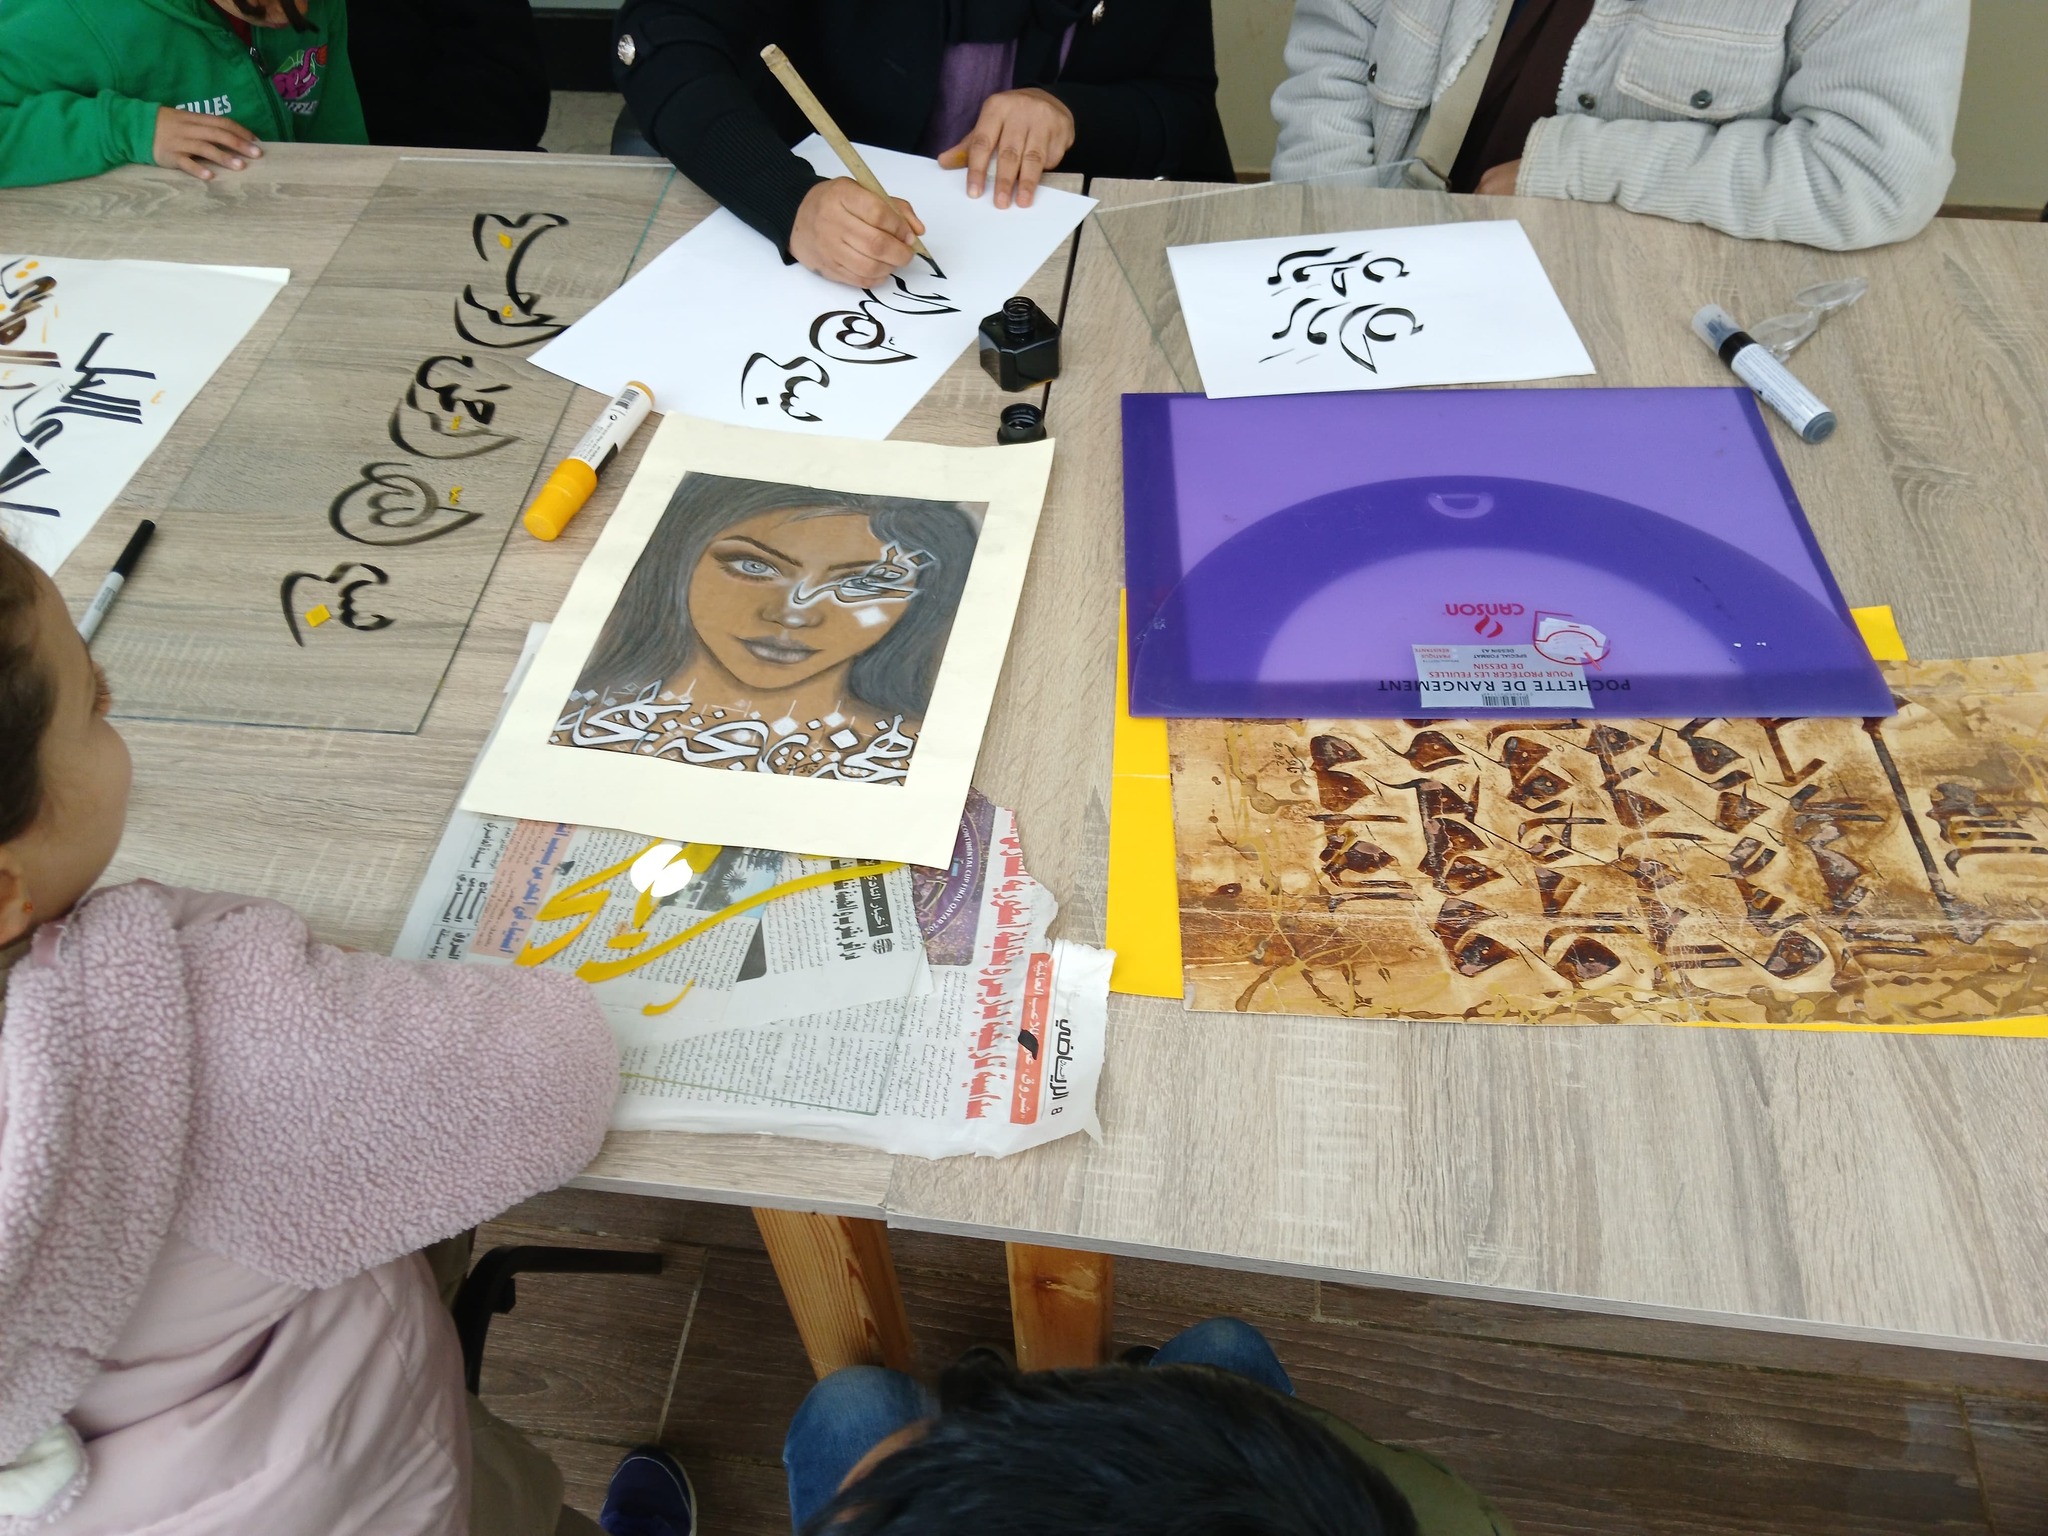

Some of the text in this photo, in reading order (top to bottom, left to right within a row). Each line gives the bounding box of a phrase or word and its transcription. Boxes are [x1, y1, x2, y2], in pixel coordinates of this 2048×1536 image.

[1474, 671, 1490, 679] LES
[1378, 679, 1631, 692] POCHETTE DE RANGEMENT
[870, 903, 889, 929] أخبار
